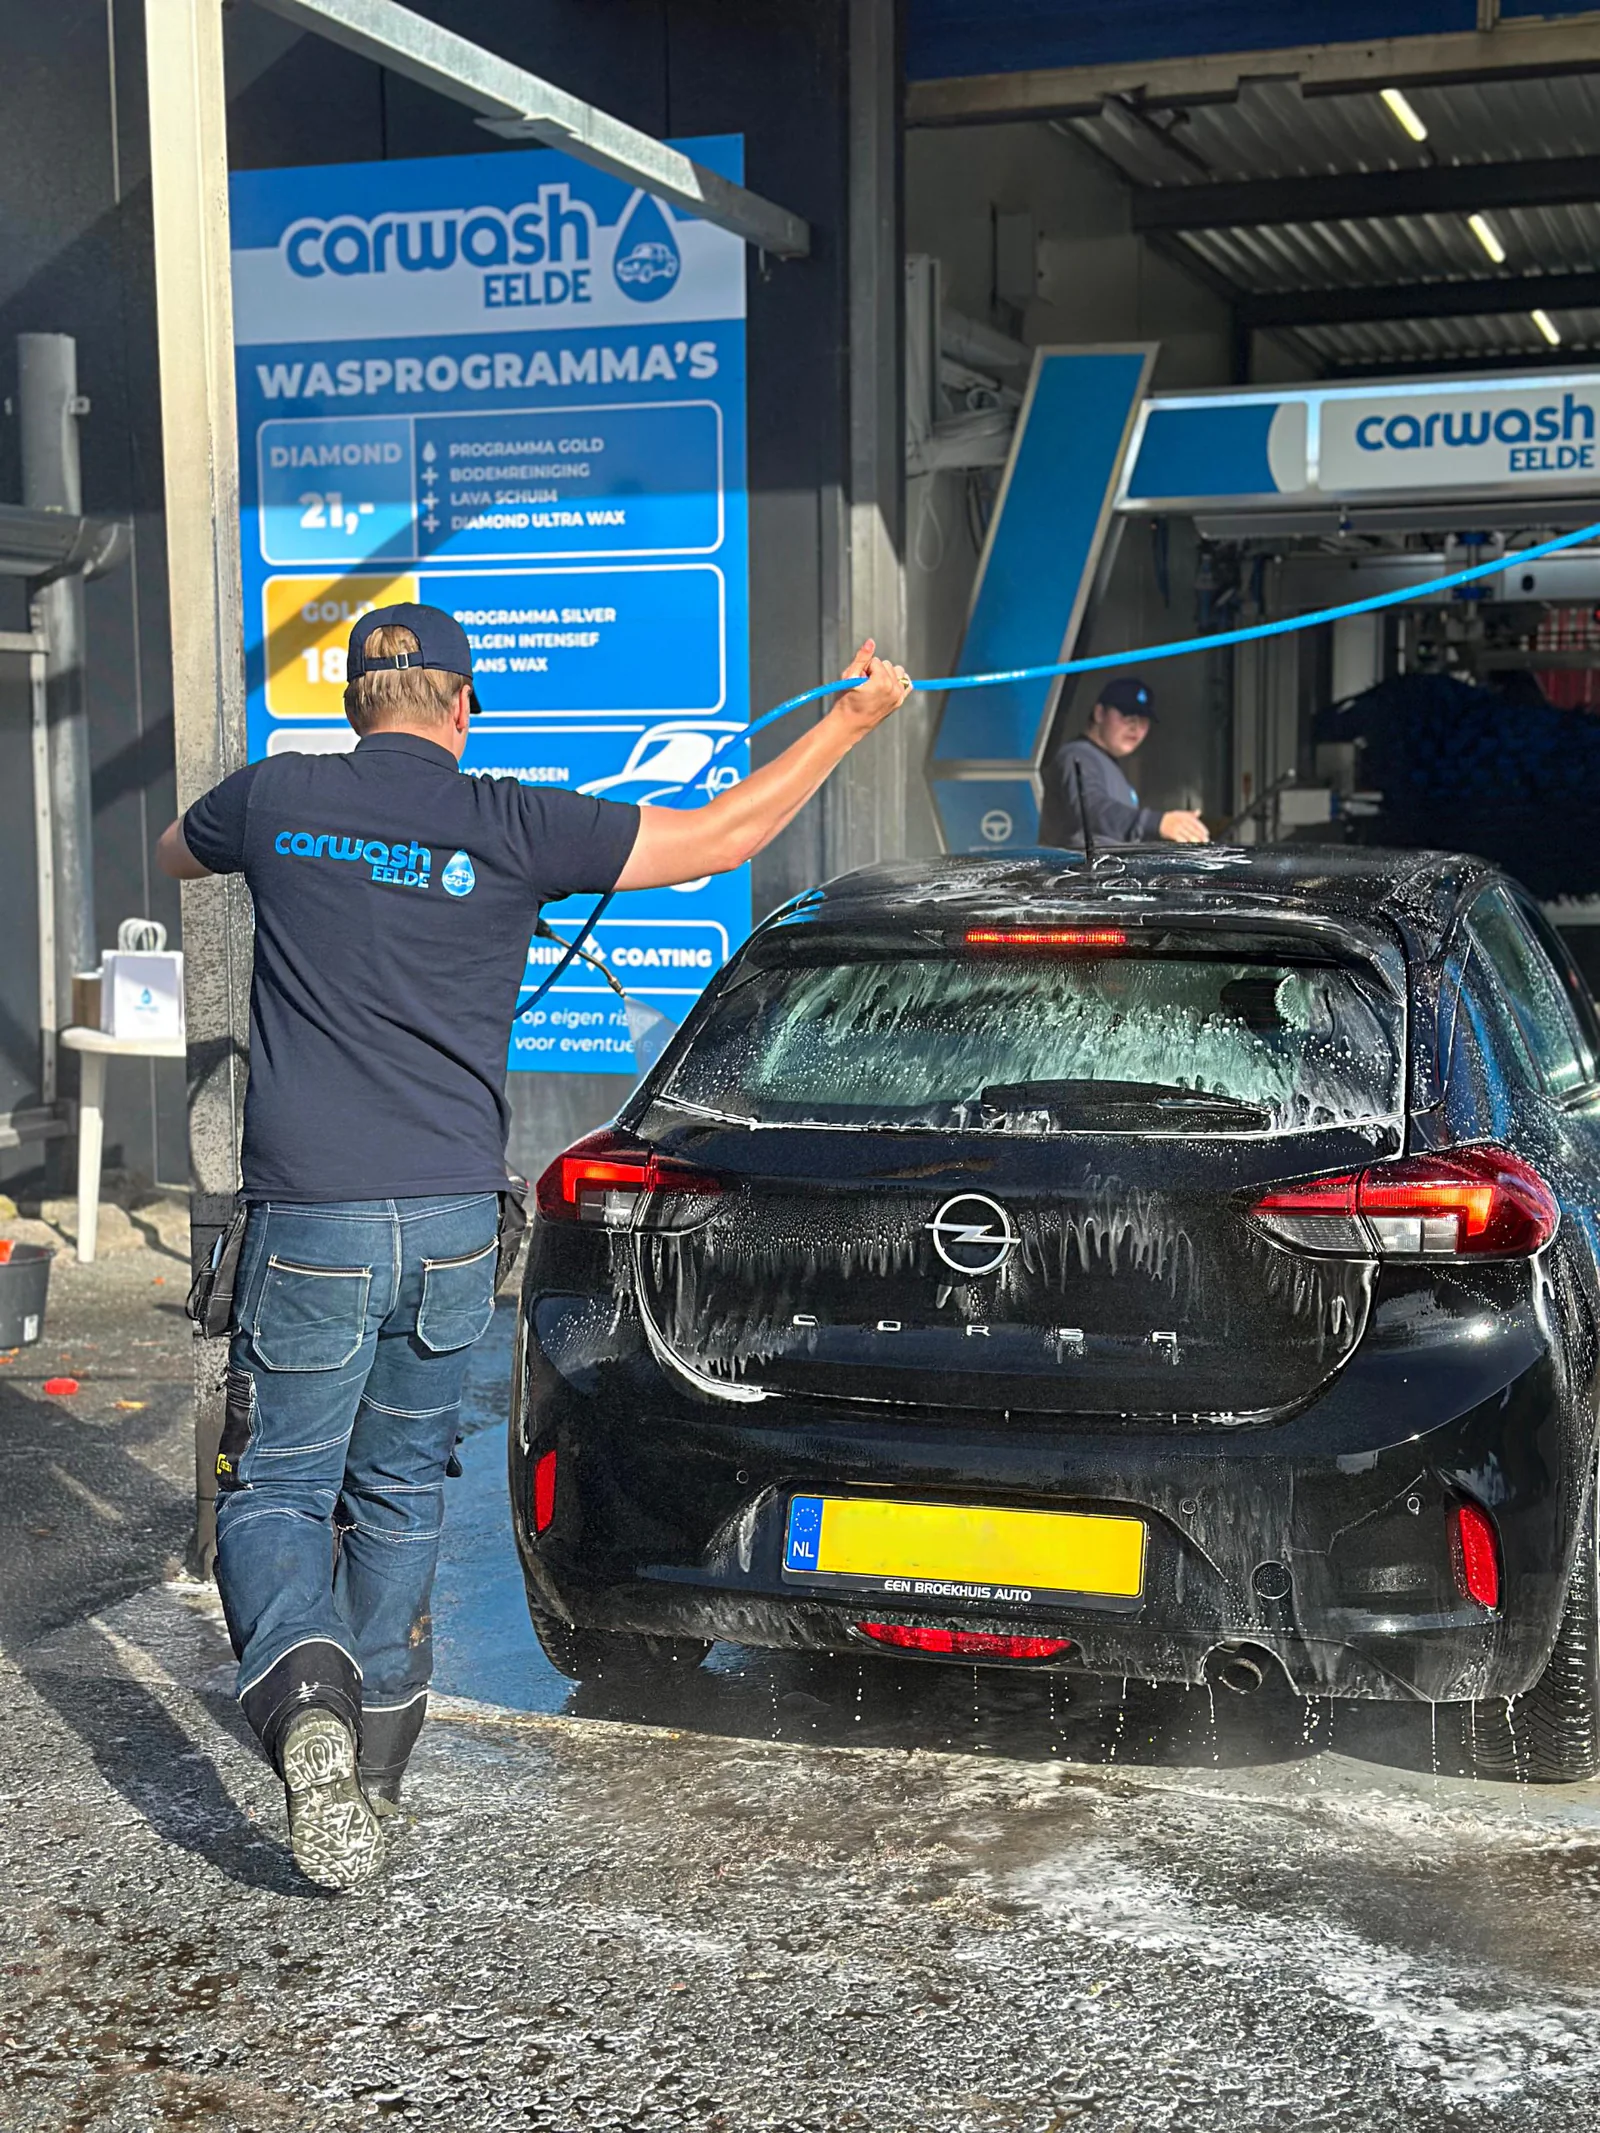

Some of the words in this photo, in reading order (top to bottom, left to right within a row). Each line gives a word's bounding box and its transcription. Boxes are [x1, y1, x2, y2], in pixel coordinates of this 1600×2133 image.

[286, 193, 591, 278] carwash
[484, 269, 591, 309] EELDE
[256, 341, 718, 399] WASPROGRAMMA'S
[1355, 393, 1595, 452] carwash
[270, 442, 403, 468] DIAMOND
[449, 441, 556, 459] PROGRAMMA
[557, 438, 605, 453] GOLD
[1508, 445, 1595, 472] EELDE
[450, 463, 590, 482] BODEMREINIGING
[451, 491, 492, 506] LAVA
[494, 488, 558, 505] SCHUIM
[299, 491, 375, 535] 21,-
[451, 513, 530, 530] DIAMOND
[531, 511, 584, 528] ULTRA
[585, 510, 626, 525] WAX
[453, 609, 559, 625] PROGRAMMA
[560, 607, 617, 624] SILVER
[467, 633, 516, 650] ELGEN
[518, 632, 600, 648] INTENSIEF
[509, 656, 549, 672] WAX
[275, 831, 432, 871] carwash
[371, 866, 431, 889] EELDE
[611, 947, 712, 968] COATING
[521, 1010, 547, 1027] op
[551, 1008, 604, 1029] eigen
[515, 1036, 556, 1051] voor
[792, 1314, 1178, 1344] CORSA
[792, 1540, 815, 1558] NL
[884, 1579, 910, 1593] EEN
[914, 1581, 992, 1599] BROEKHUIS
[993, 1588, 1032, 1602] AUTO
